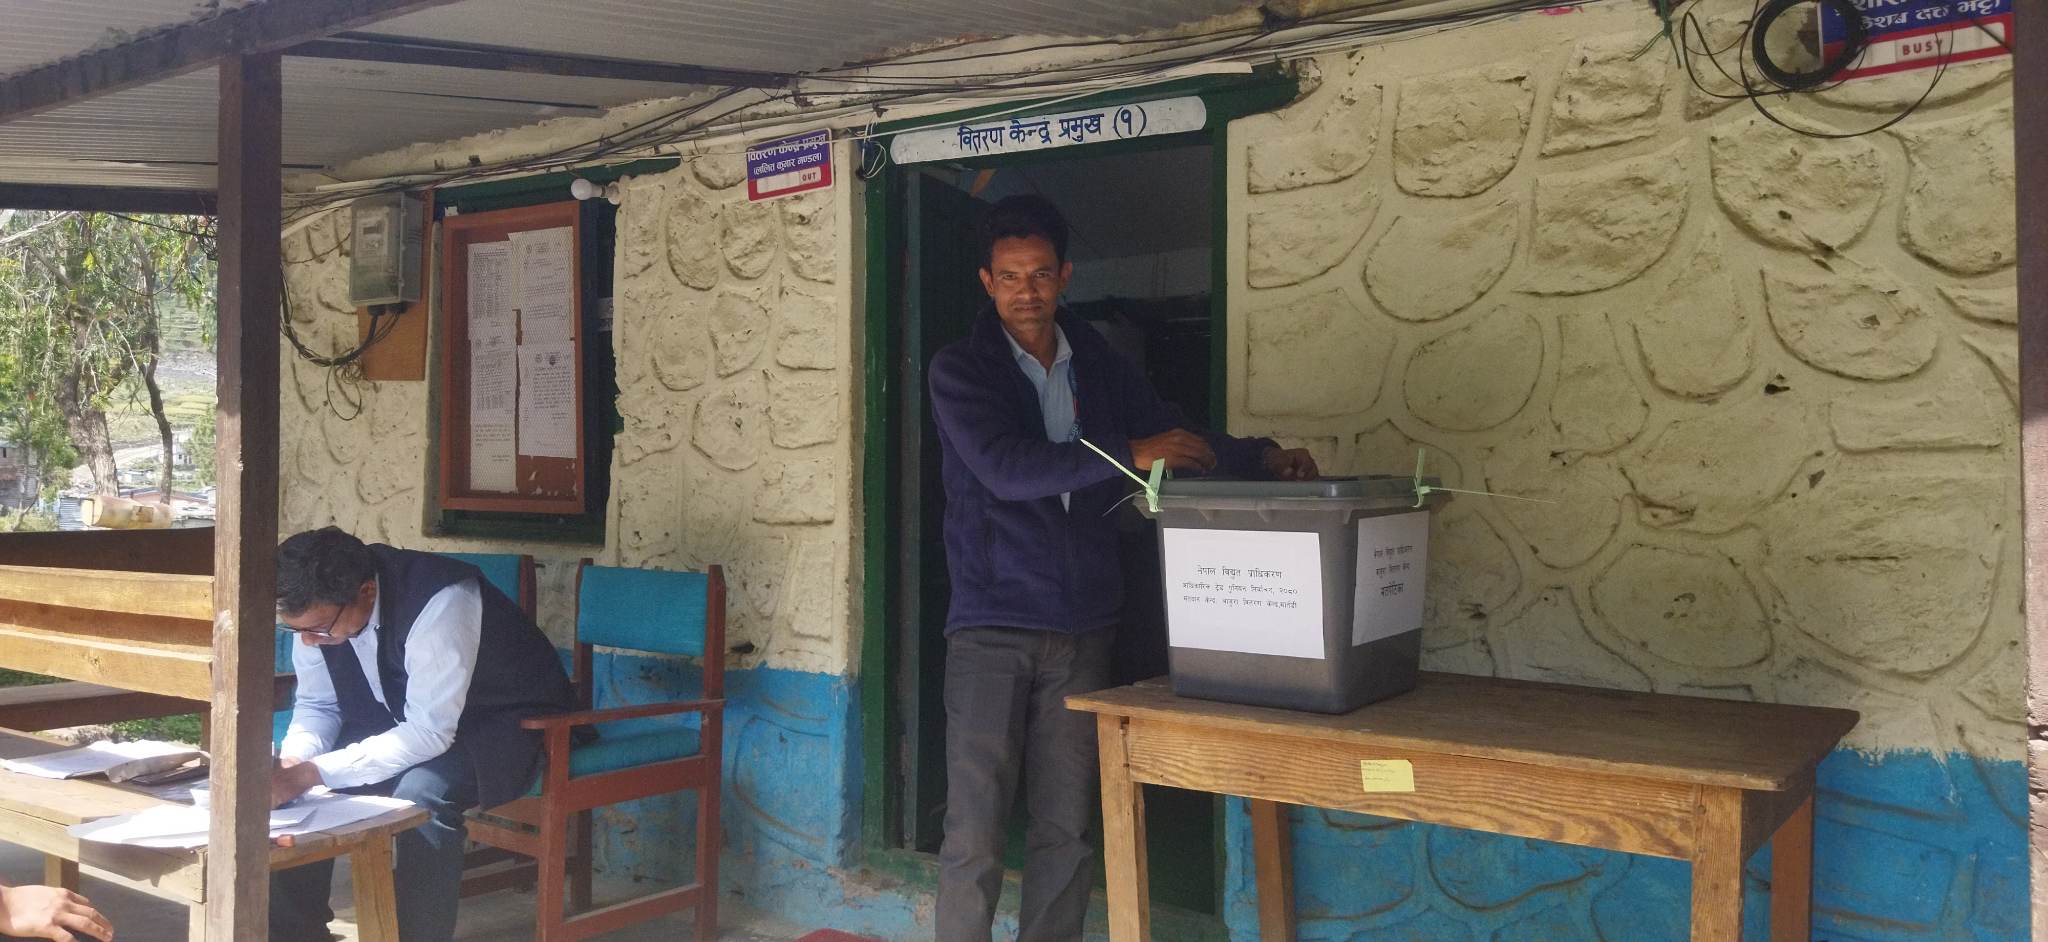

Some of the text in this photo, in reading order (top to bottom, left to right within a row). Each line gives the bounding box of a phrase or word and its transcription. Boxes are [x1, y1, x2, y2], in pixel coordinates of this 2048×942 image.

[1902, 39, 1943, 56] BUSY
[958, 104, 1147, 154] वितरण केन्द्र प्रमुख (१)
[776, 157, 797, 172] कुमार
[802, 172, 817, 182] OUT
[1197, 564, 1283, 580] नेपाल विद्युत प्राधिकरण
